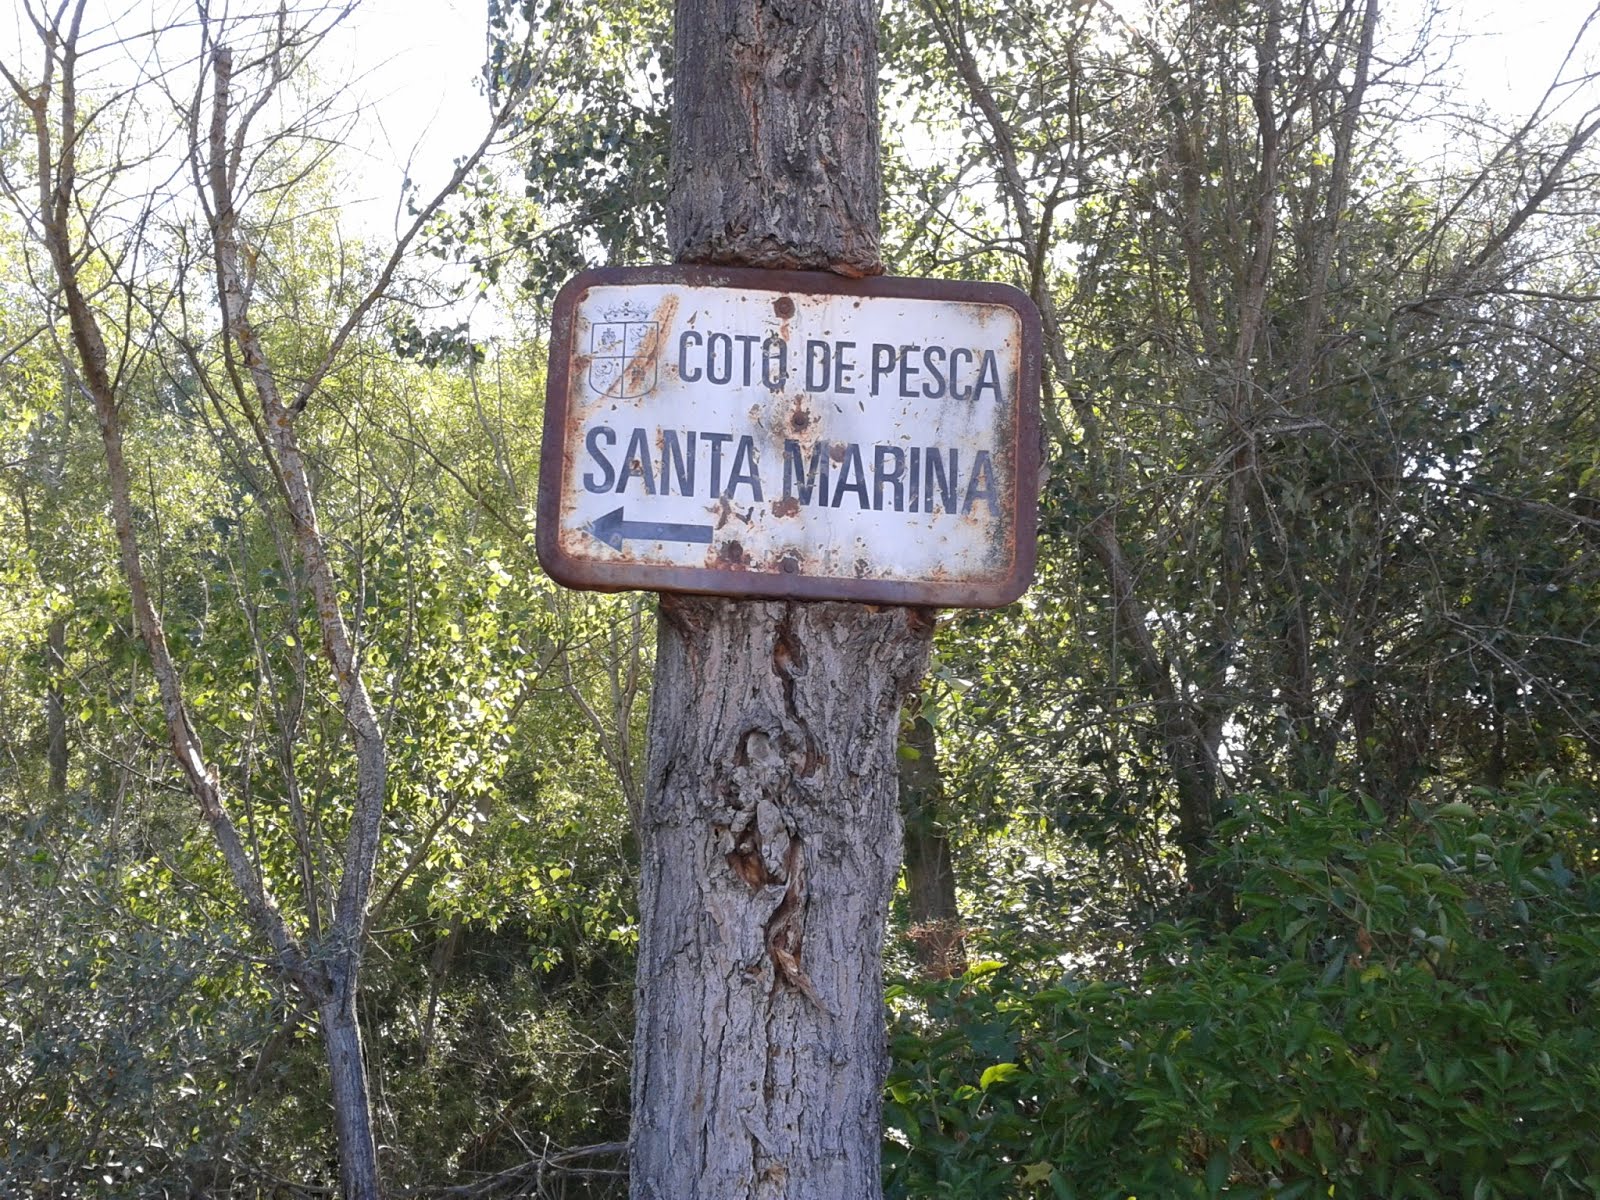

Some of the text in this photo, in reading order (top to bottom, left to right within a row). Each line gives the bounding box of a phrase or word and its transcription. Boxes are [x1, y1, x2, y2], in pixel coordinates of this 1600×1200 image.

[678, 330, 1002, 401] COTO DE PESCA
[583, 426, 999, 516] SANTA MARINA
